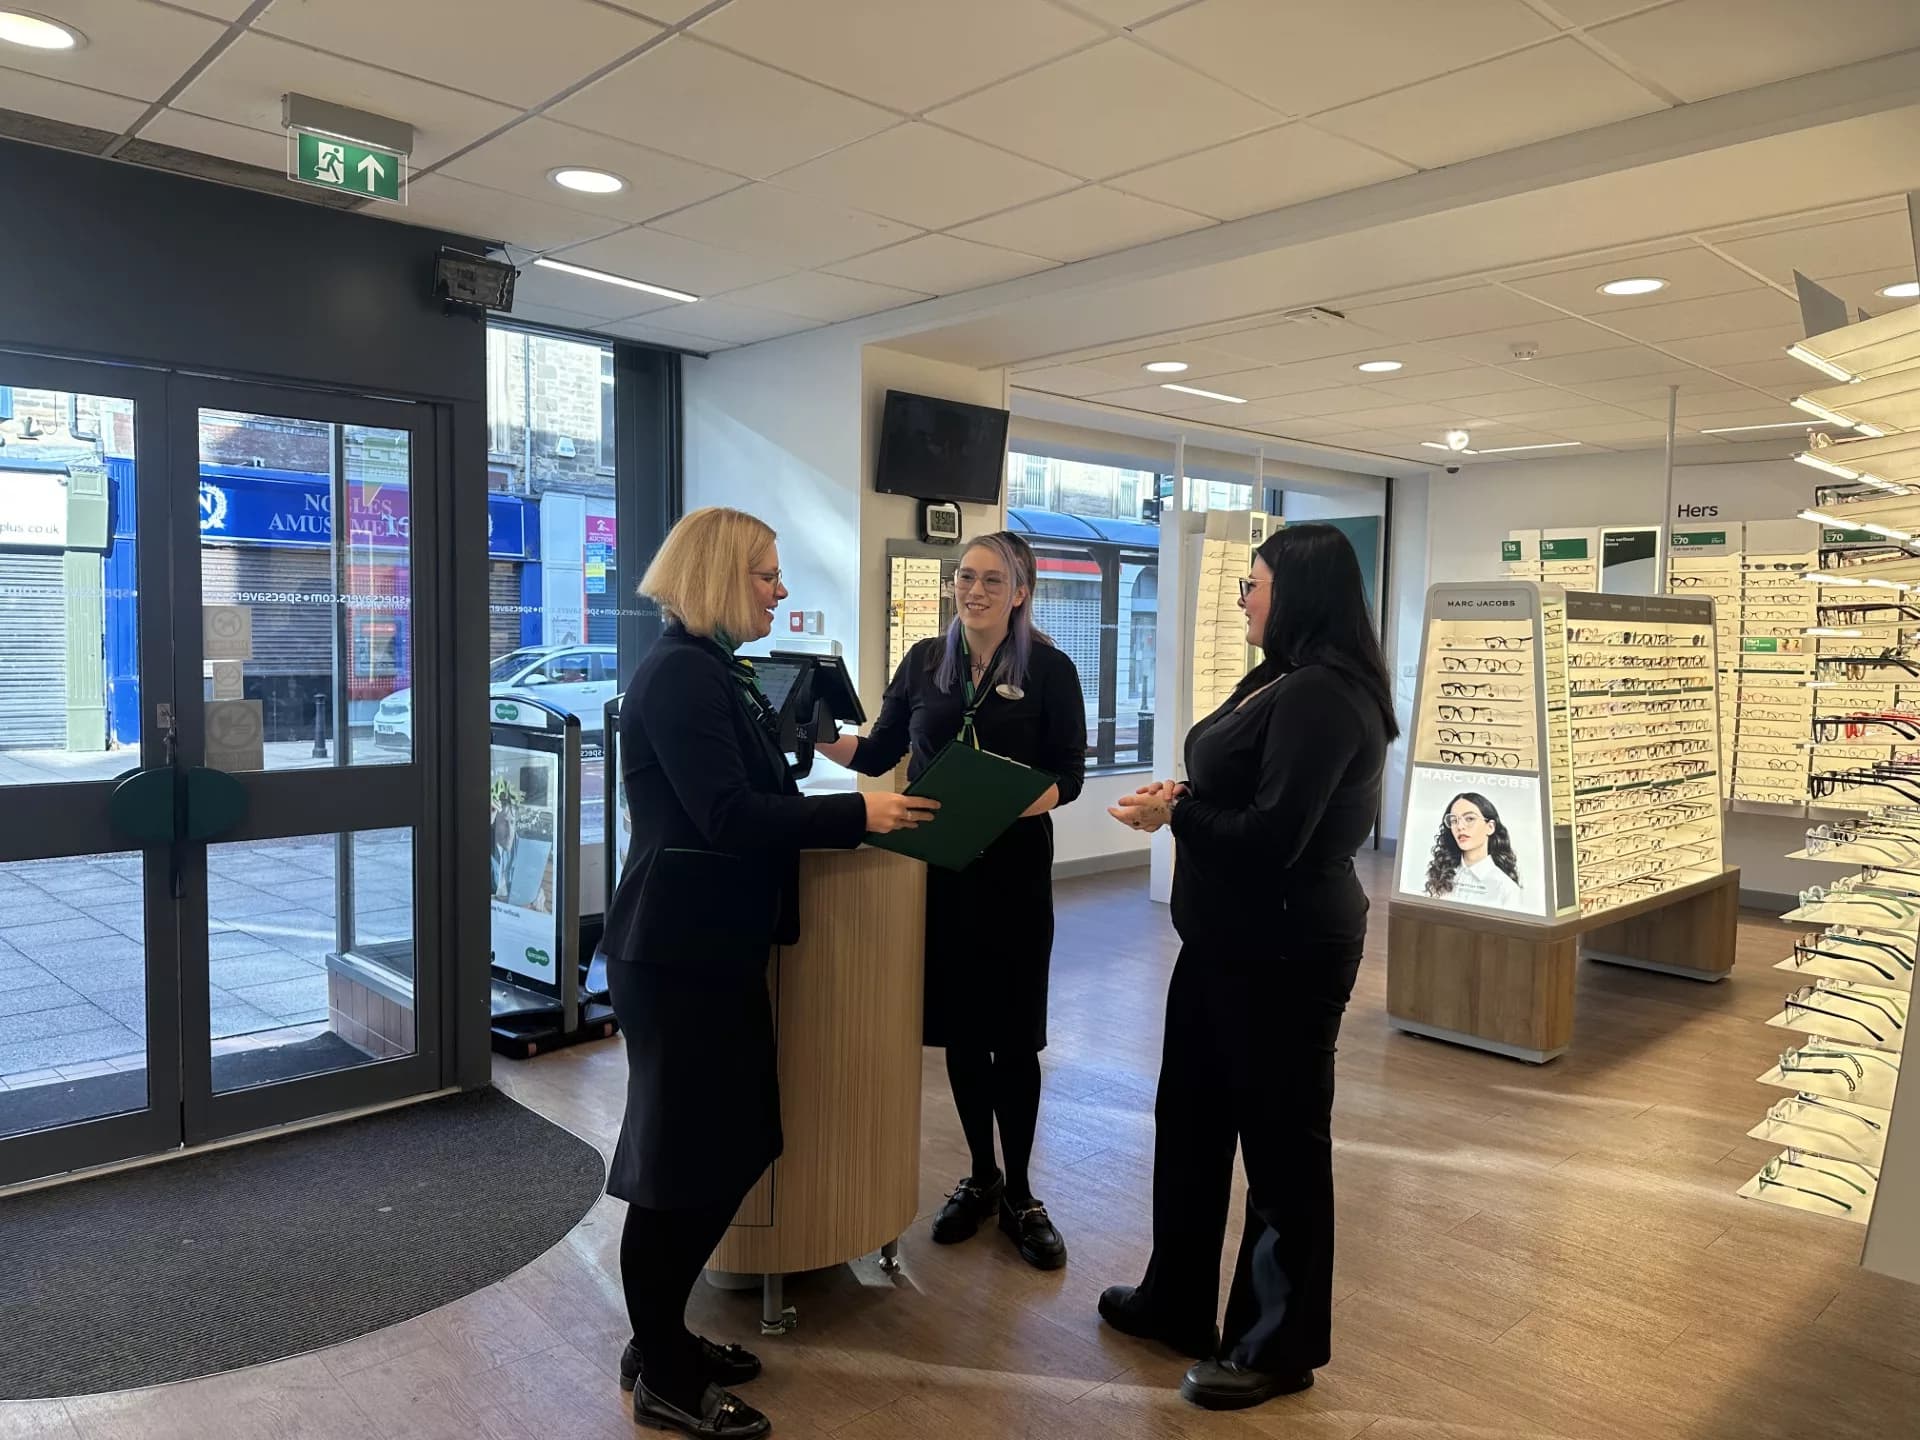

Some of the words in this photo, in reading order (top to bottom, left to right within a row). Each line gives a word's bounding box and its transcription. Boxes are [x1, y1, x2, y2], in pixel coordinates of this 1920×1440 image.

[1677, 503, 1719, 518] Hers
[1423, 770, 1464, 783] MARC
[1467, 775, 1531, 788] JACOBS
